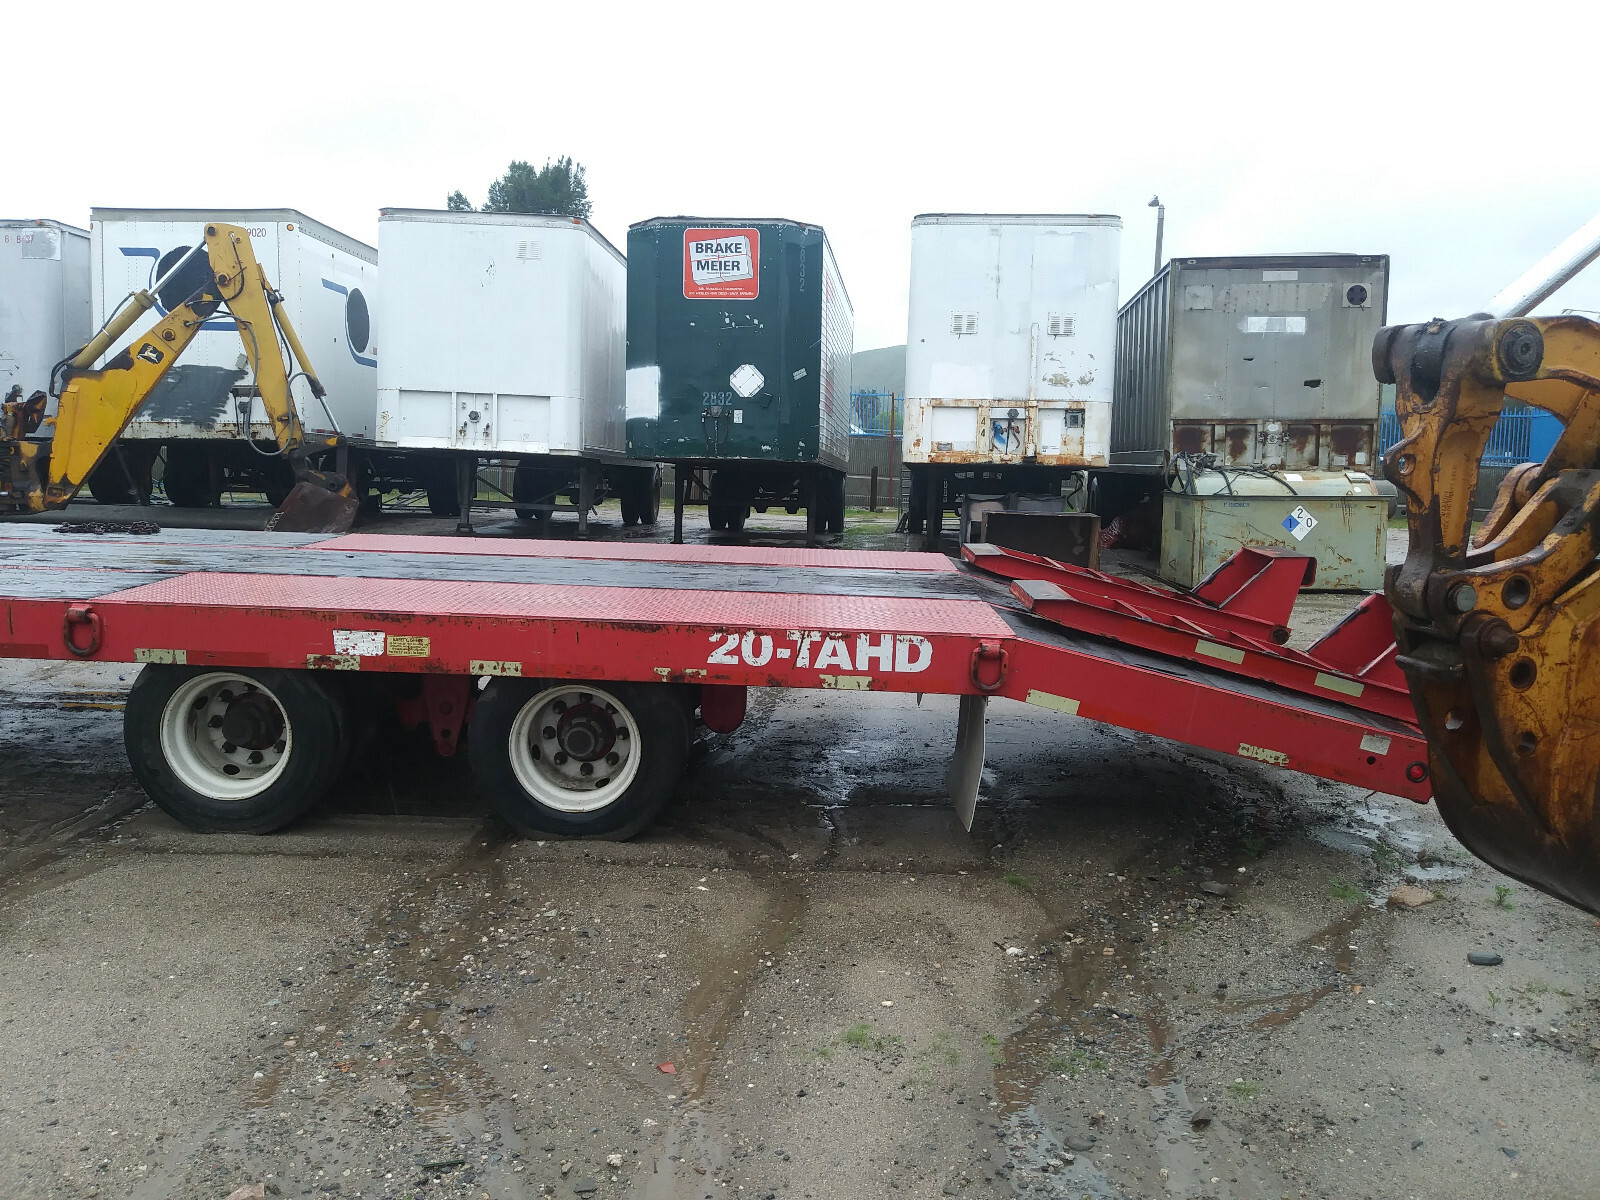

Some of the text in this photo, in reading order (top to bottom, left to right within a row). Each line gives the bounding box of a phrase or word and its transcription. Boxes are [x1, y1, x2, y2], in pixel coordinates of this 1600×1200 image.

[695, 243, 742, 254] BRAKE
[696, 260, 741, 271] MEIER
[702, 391, 732, 406] 2832
[1297, 507, 1304, 519] 2
[1288, 517, 1313, 529] 1 0
[707, 629, 933, 673] 20-TAHD
